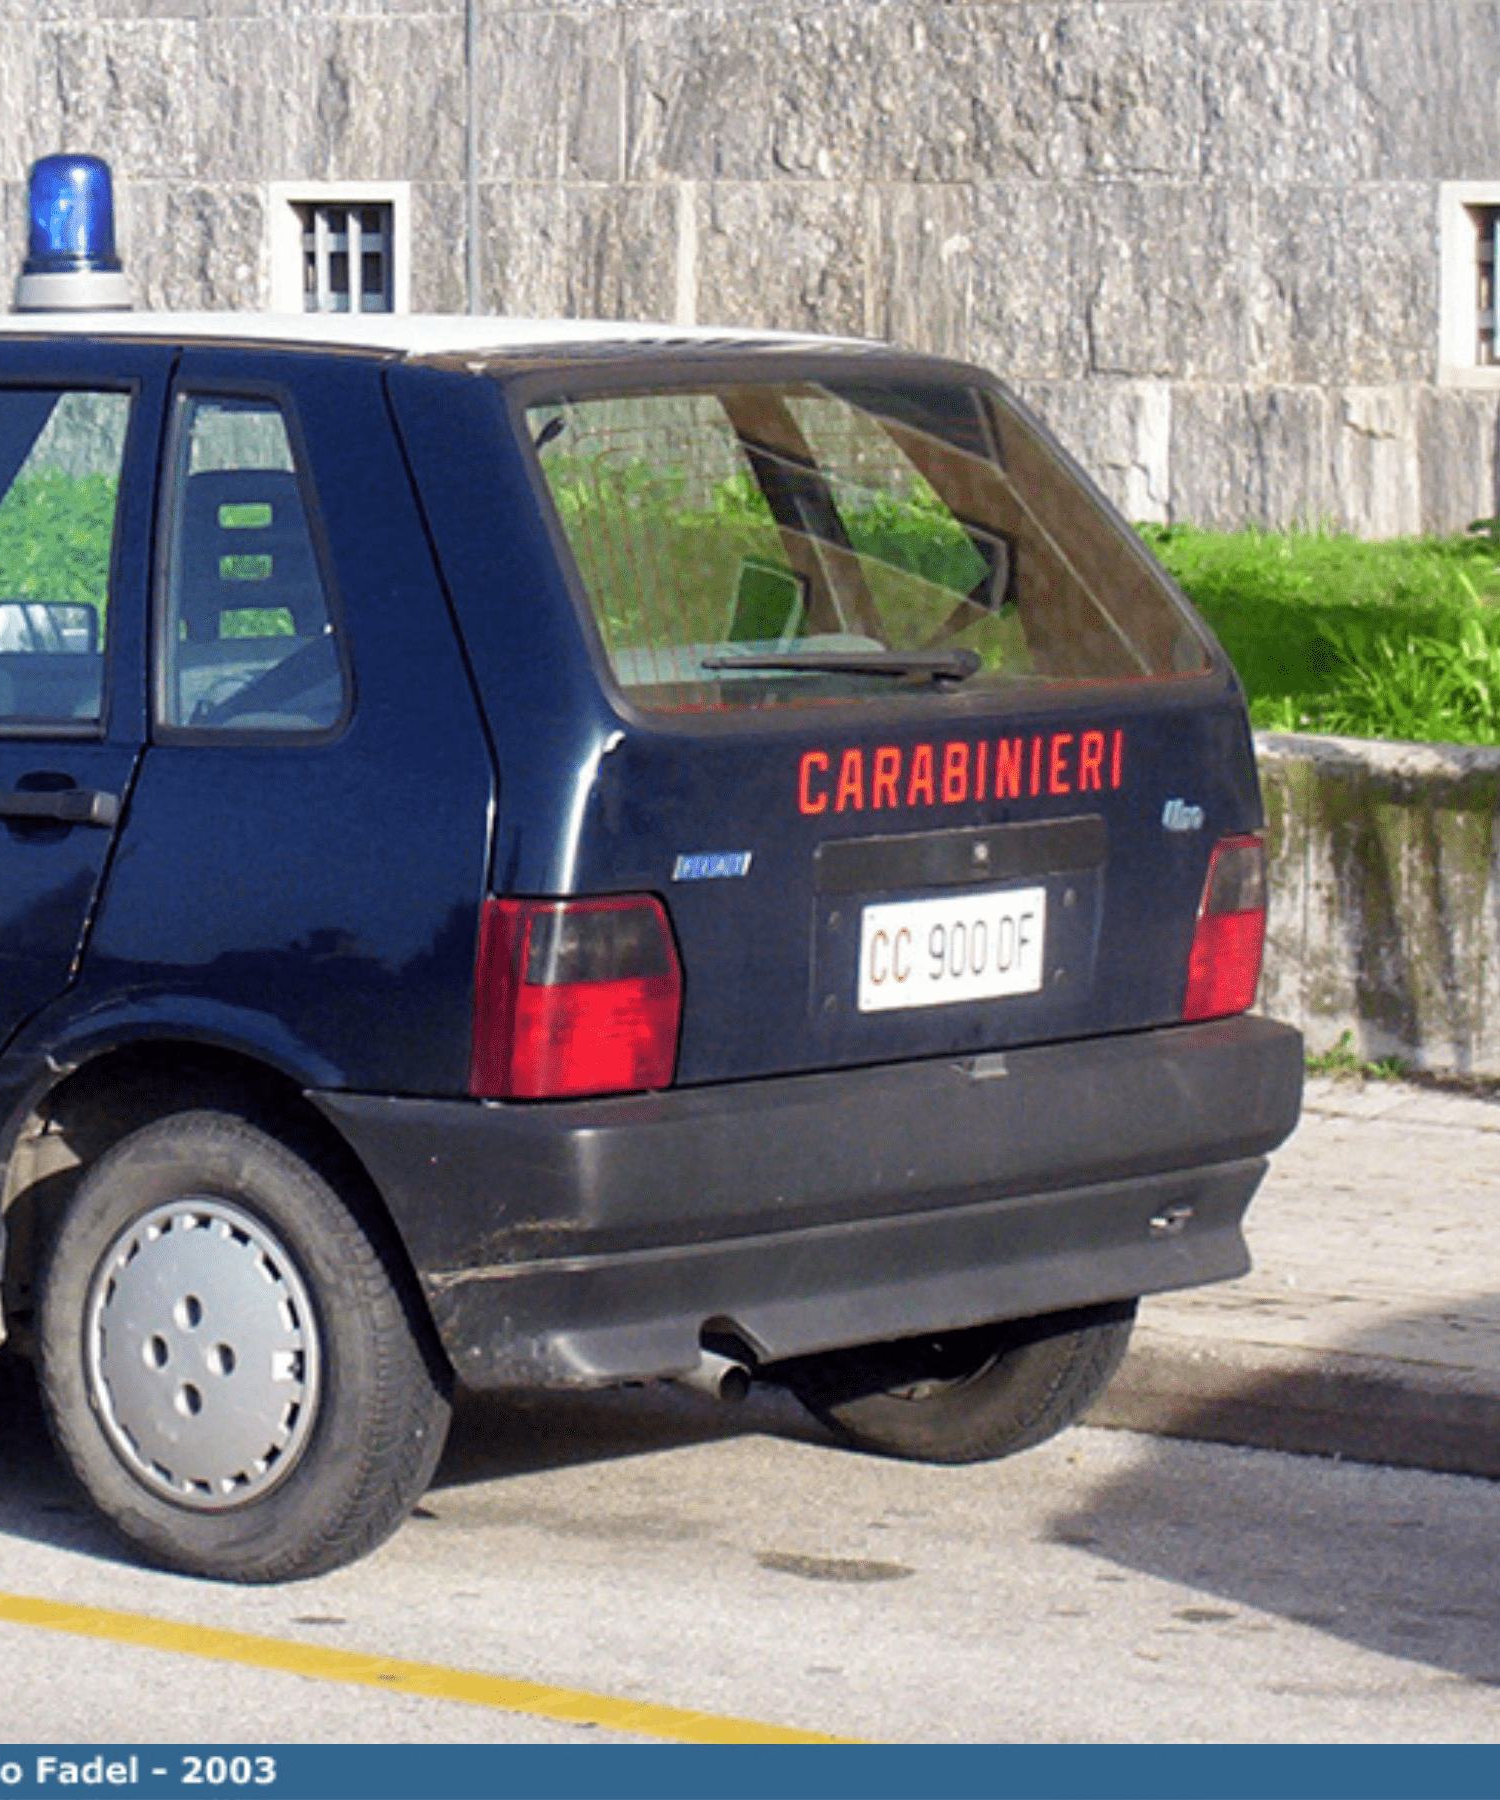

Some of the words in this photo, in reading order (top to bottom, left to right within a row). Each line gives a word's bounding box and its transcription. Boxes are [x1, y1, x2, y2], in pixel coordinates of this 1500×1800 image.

[798, 730, 1123, 815] CARABINIERI
[869, 929, 912, 987] CC
[928, 922, 989, 982] 900
[997, 911, 1035, 974] DF
